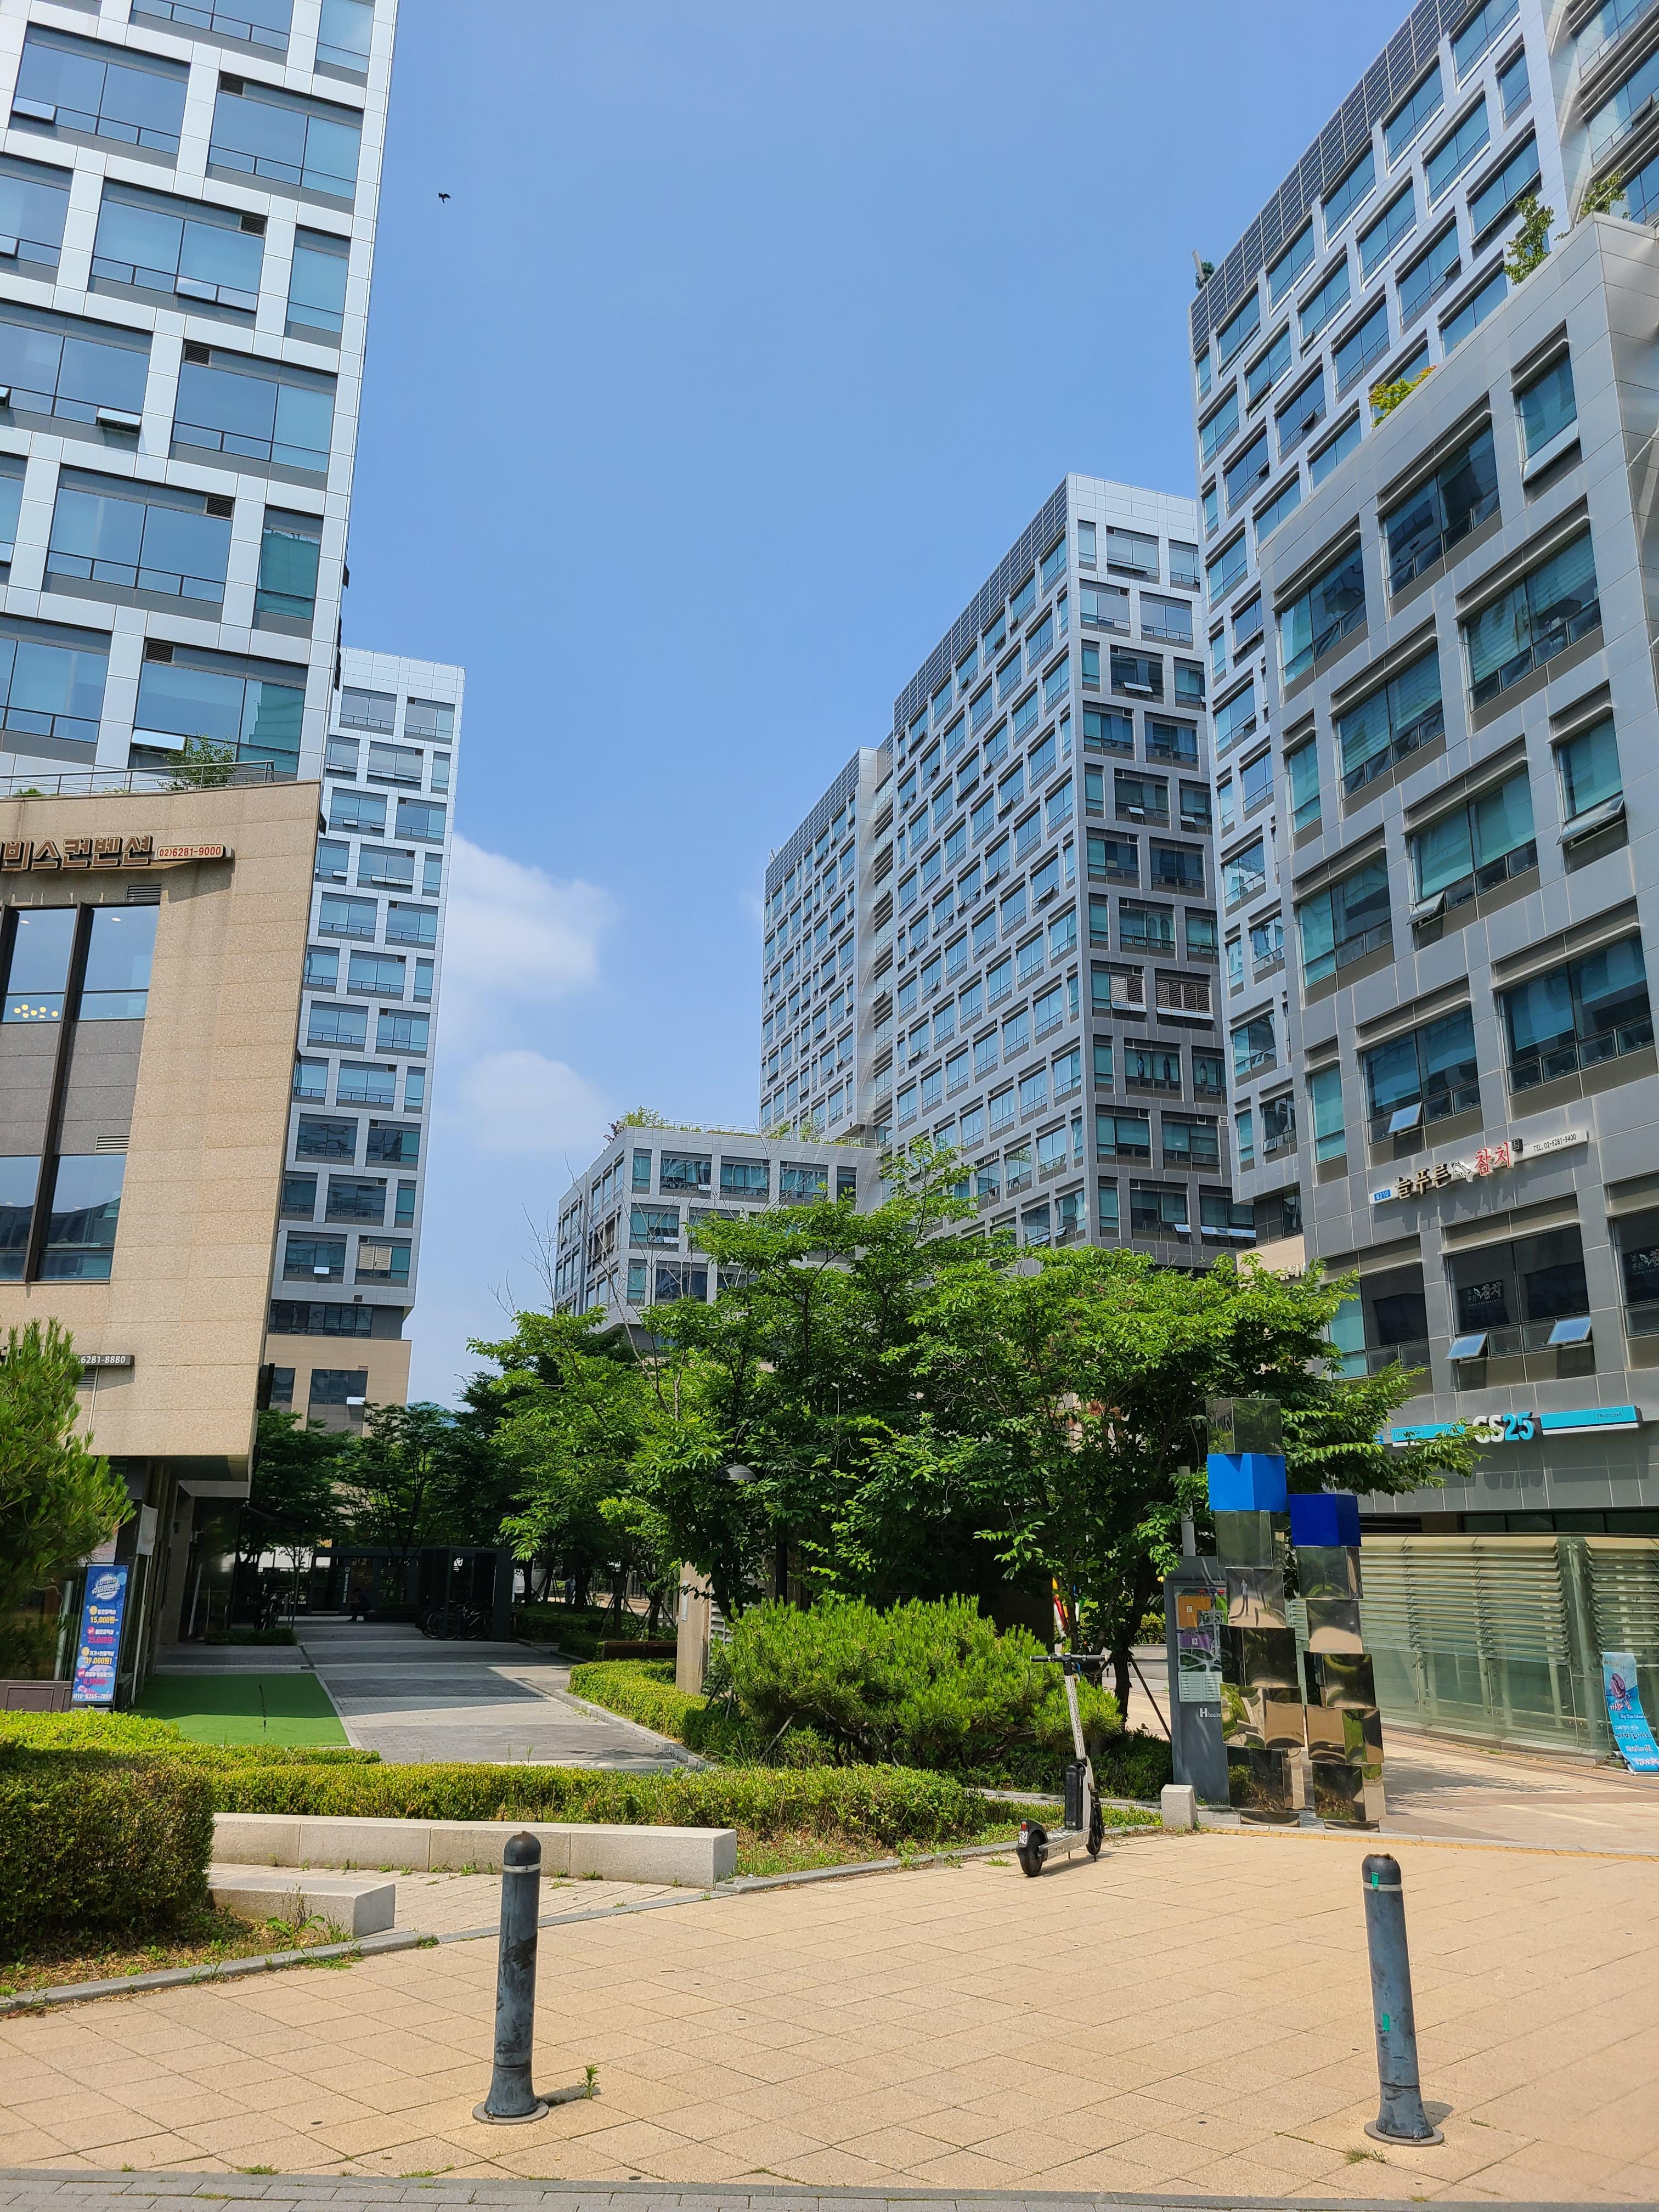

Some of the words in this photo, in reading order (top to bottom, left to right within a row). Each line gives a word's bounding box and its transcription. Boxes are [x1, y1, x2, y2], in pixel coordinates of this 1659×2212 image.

[0, 835, 153, 870] 비스컨벤션
[159, 845, 222, 857] 02)6281-9000
[1375, 1191, 1389, 1200] B210
[1395, 1163, 1451, 1199] 늘푸른
[1474, 1141, 1511, 1176] 참치
[1533, 1144, 1543, 1153] TEL.
[1544, 1133, 1576, 1149] 02-6281-9400
[77, 1356, 126, 1364] .6281-8880
[1472, 1411, 1534, 1443] GS25
